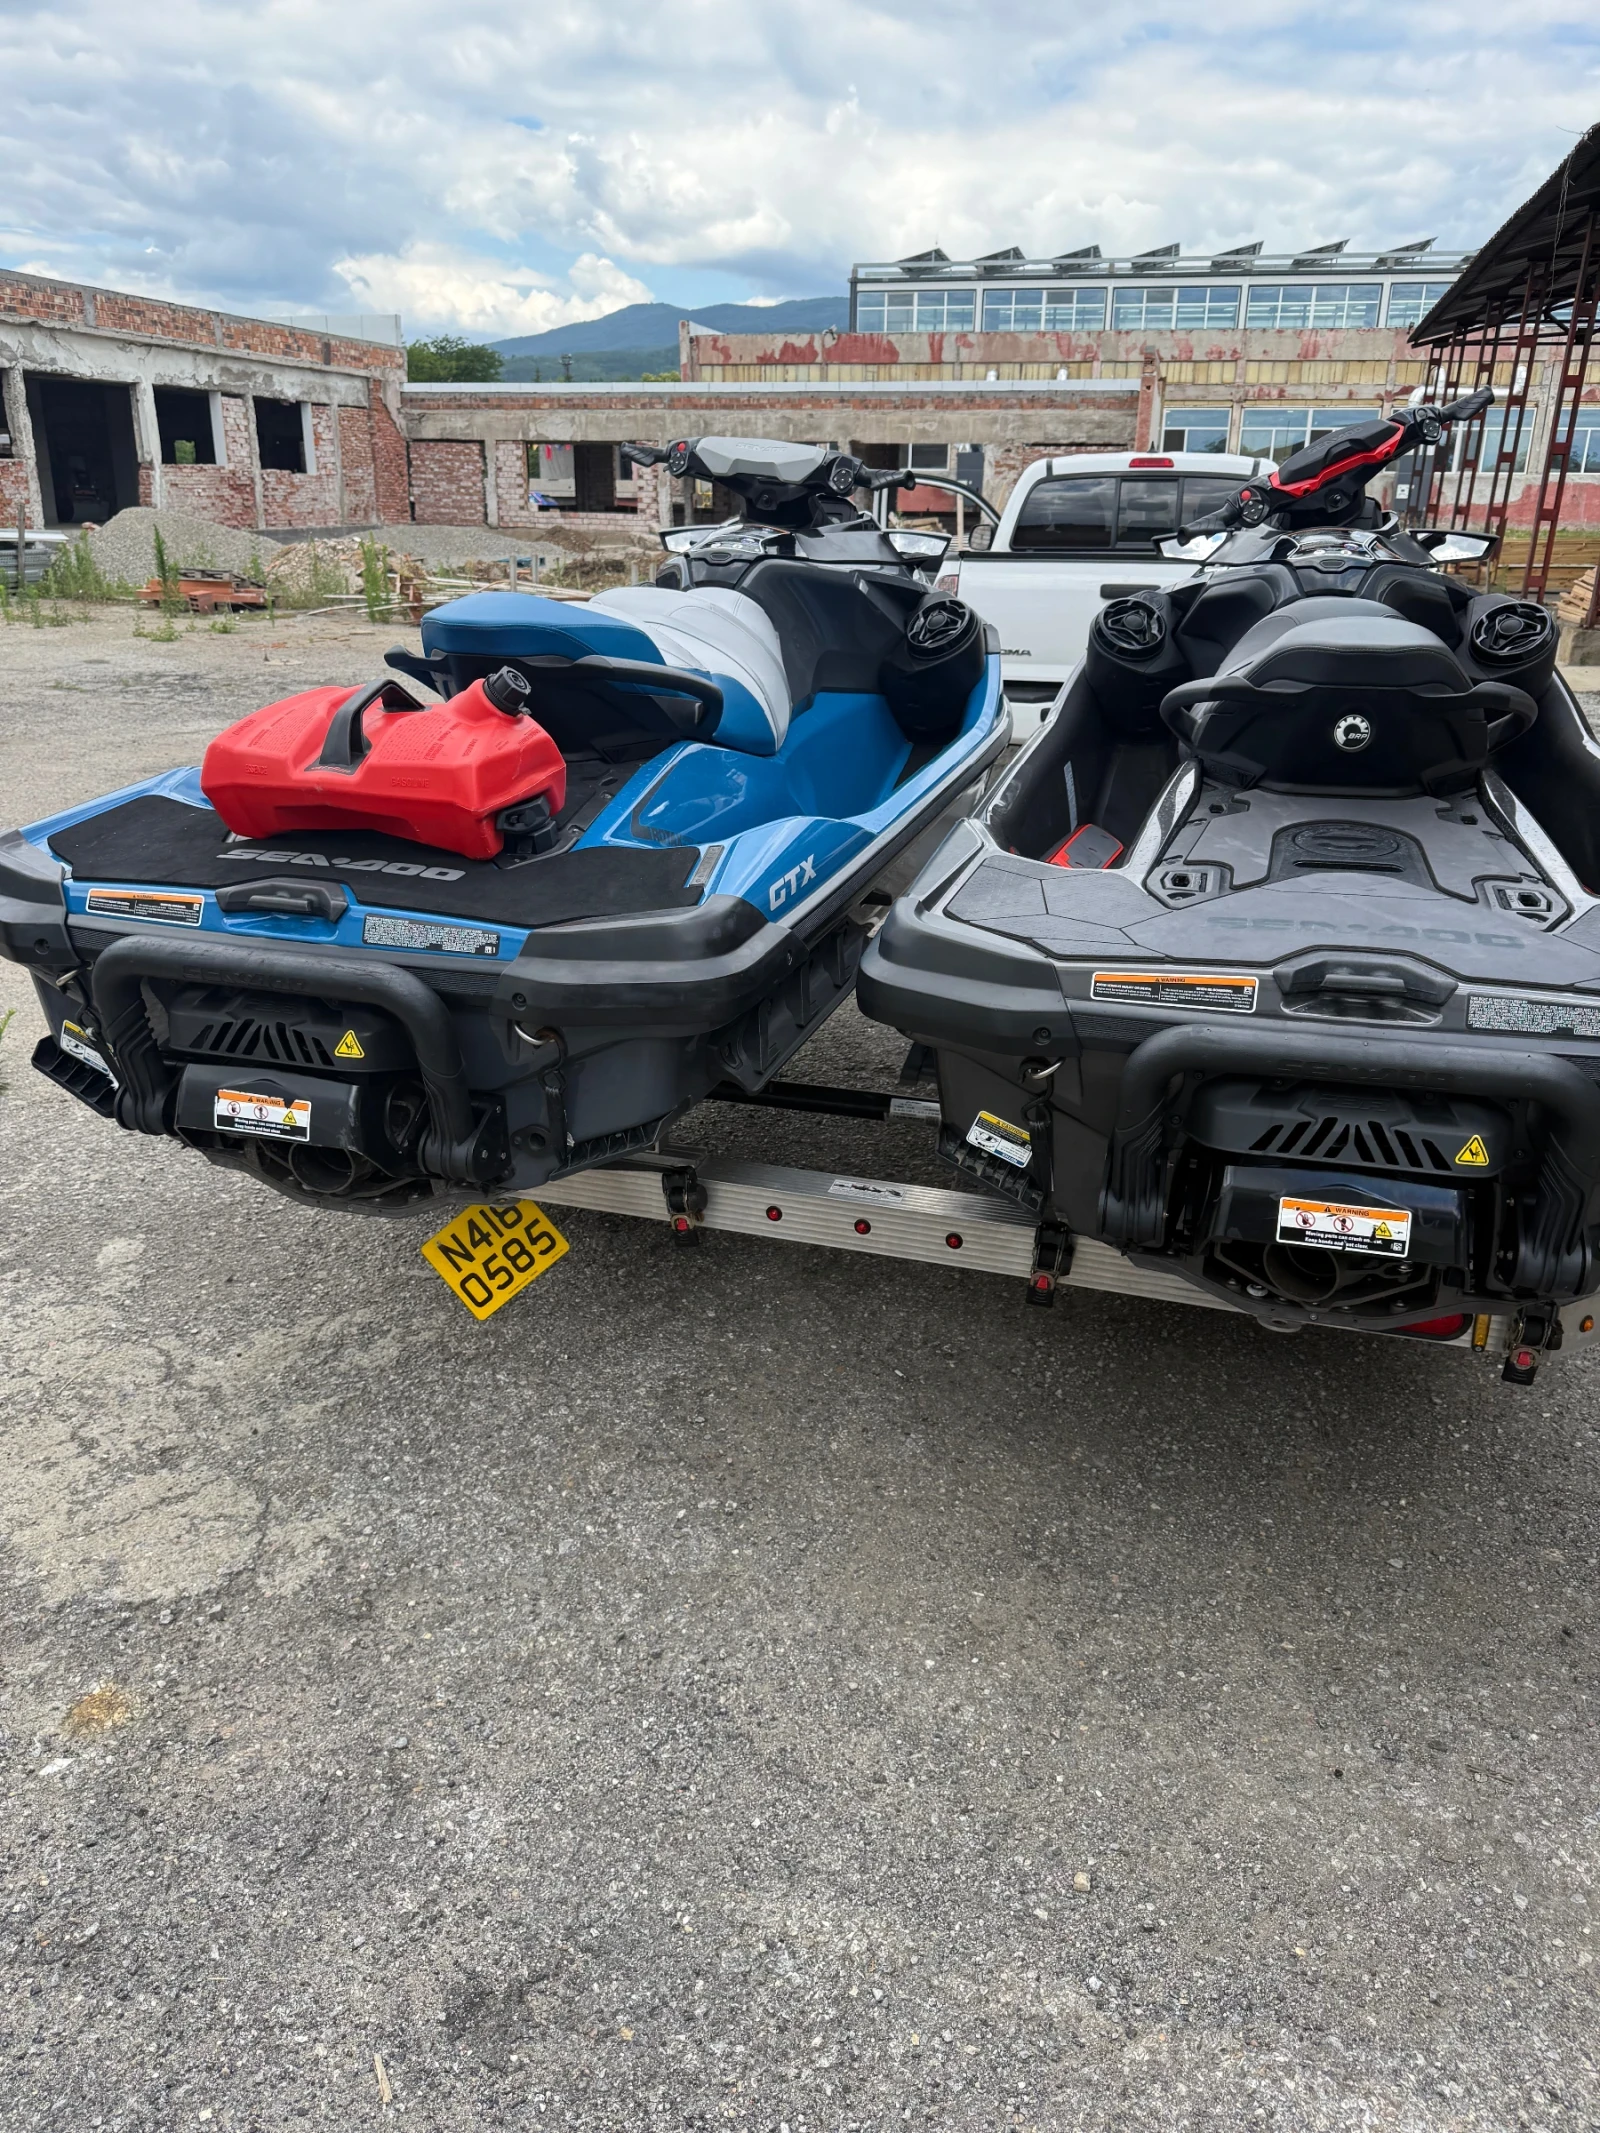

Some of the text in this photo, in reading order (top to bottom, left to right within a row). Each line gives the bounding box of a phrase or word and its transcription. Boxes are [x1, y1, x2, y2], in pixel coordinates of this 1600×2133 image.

[1347, 732, 1368, 740] BRP
[391, 776, 430, 789] GASOLINE
[769, 853, 817, 912] GTX
[1335, 1207, 1370, 1217] WARNING
[1305, 1230, 1324, 1238] Moving
[1305, 1236, 1318, 1244] Keep
[1355, 1242, 1368, 1250] clear.
[459, 1217, 557, 1308] 0585
